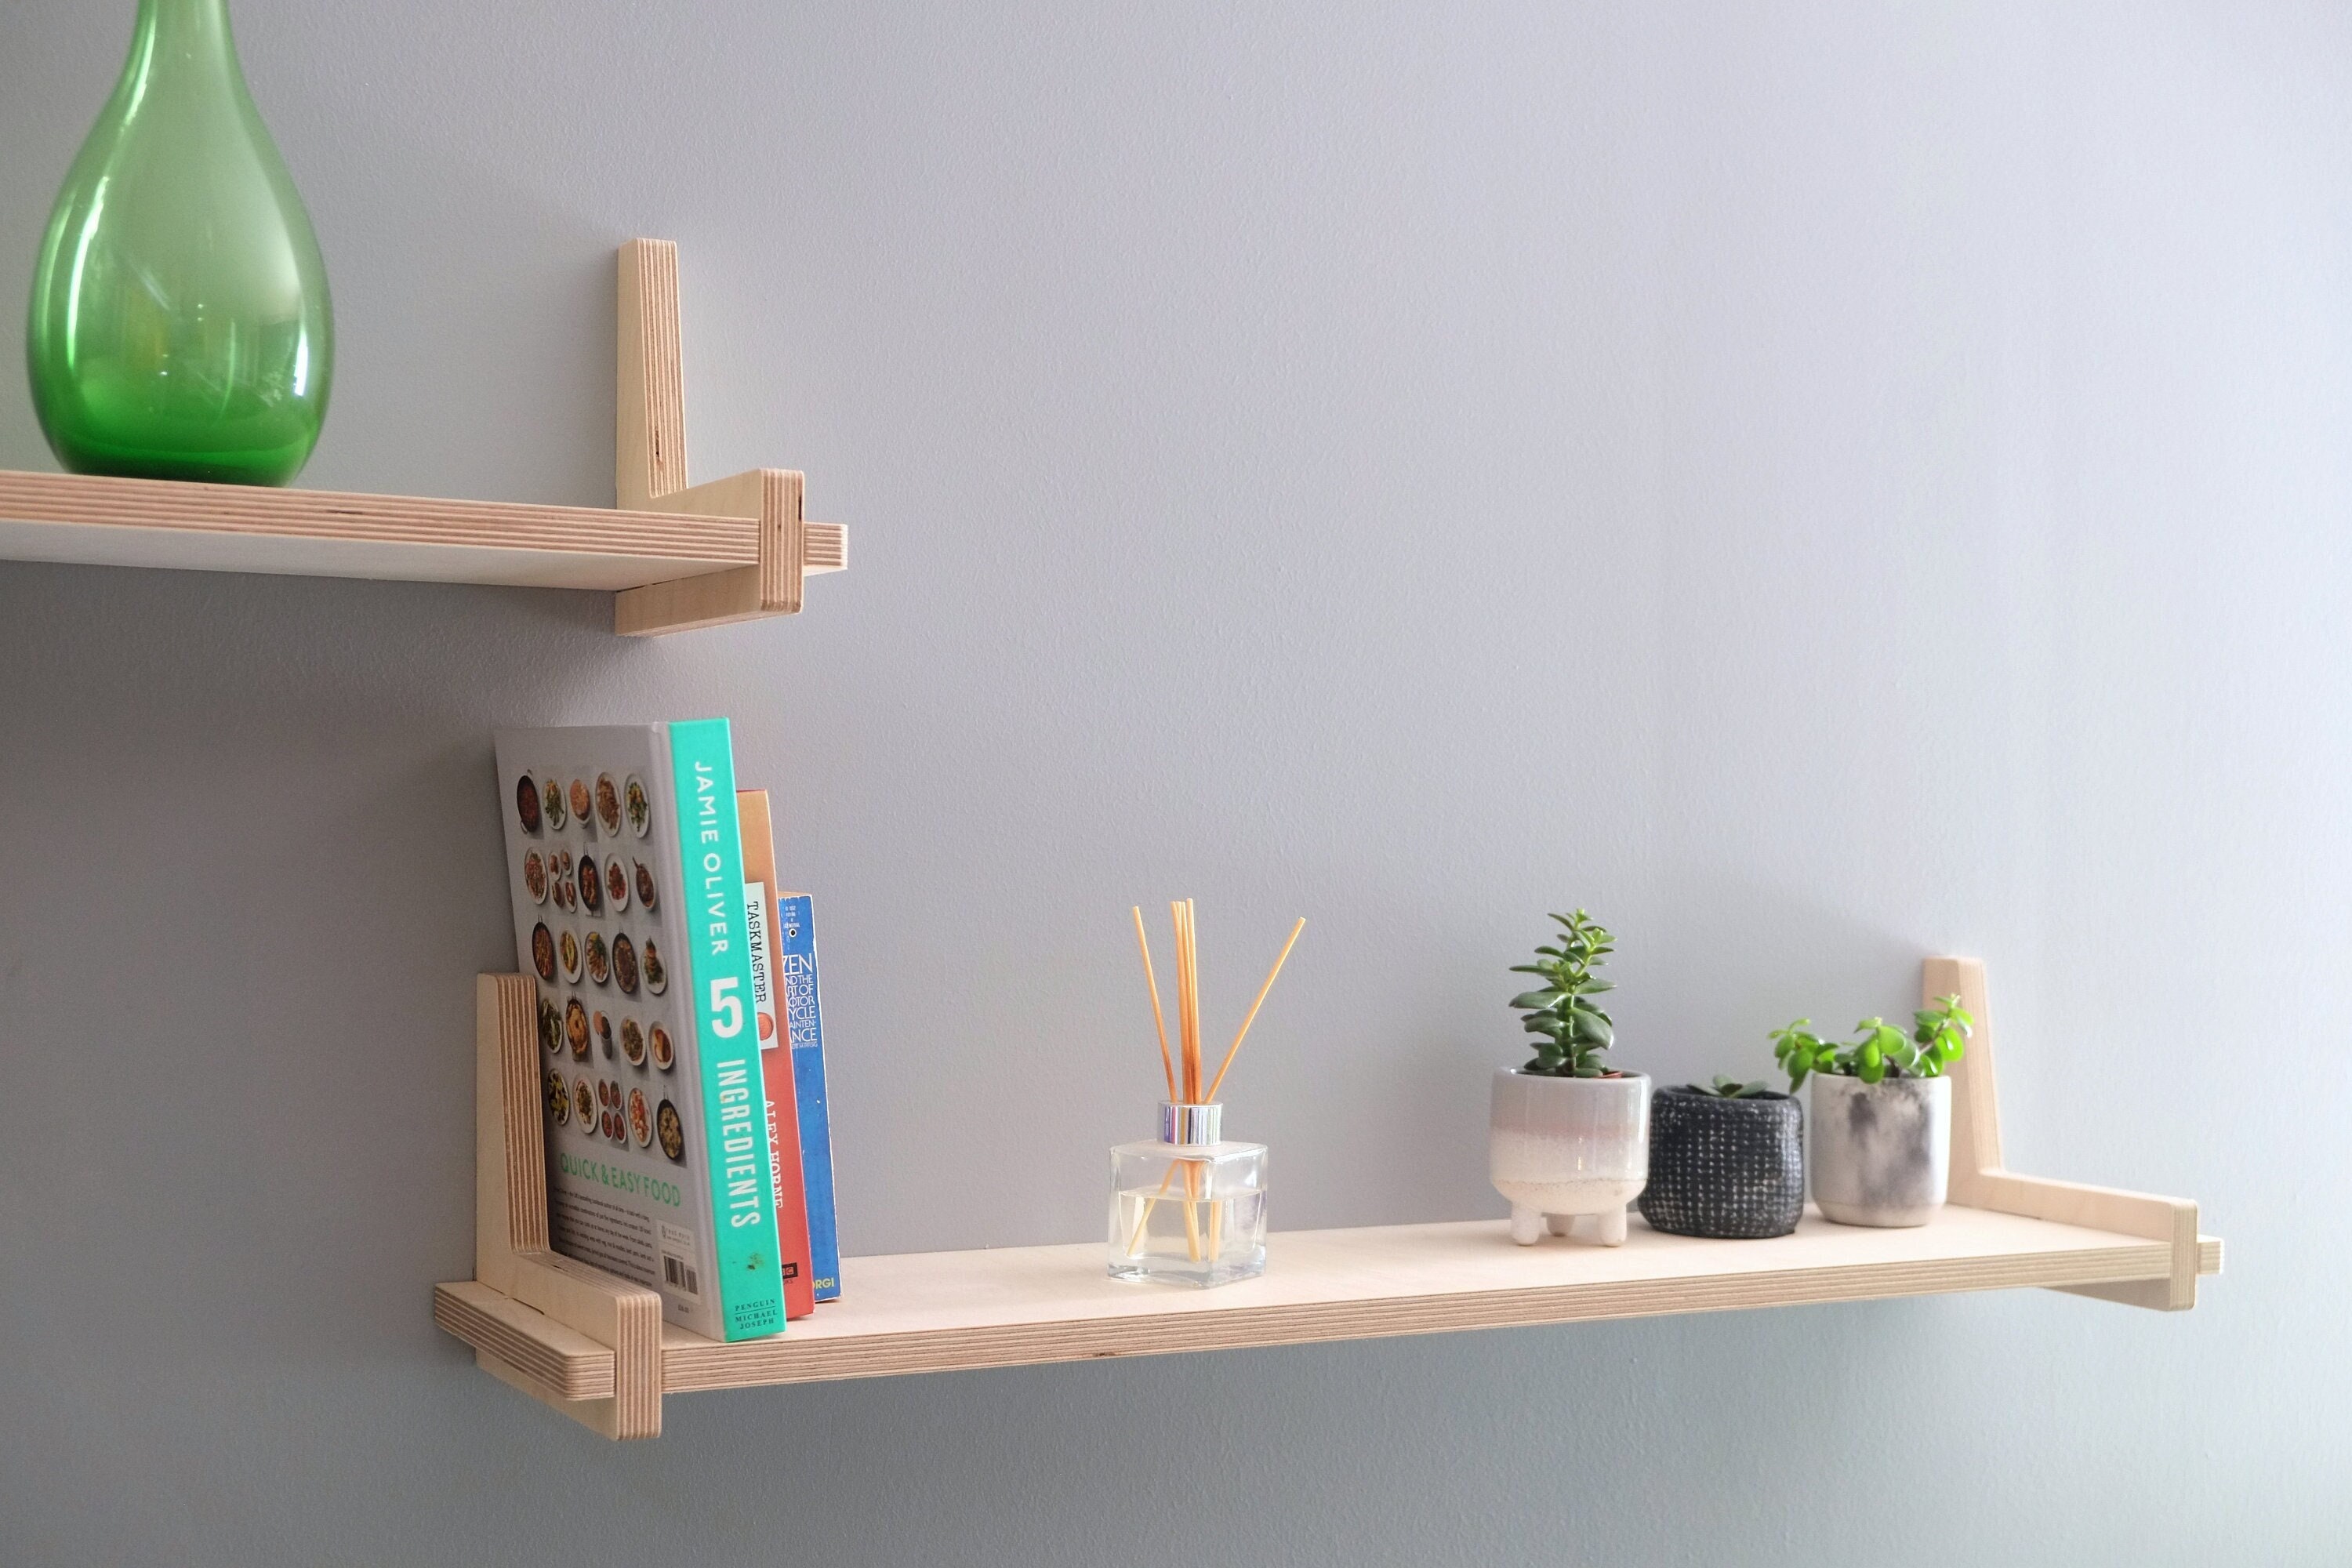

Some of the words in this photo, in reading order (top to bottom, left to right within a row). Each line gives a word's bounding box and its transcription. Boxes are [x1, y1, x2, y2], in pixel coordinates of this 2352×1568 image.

[695, 760, 720, 844] JAMIE
[703, 852, 729, 956] OLIVER
[746, 901, 766, 1004] TASKMASTER
[785, 975, 797, 985] ND
[798, 974, 814, 984] THE
[786, 985, 798, 996] RT
[799, 984, 814, 996] OF
[710, 976, 743, 1038] 5
[788, 996, 815, 1007] OTOR
[789, 1006, 816, 1021] YCLE
[789, 1019, 816, 1029] AINTEN-
[790, 1028, 817, 1043] NCE
[717, 1059, 760, 1228] INGREDIENTS
[560, 1152, 599, 1182] QUICK
[601, 1164, 609, 1185] &
[611, 1167, 641, 1194] EASY
[643, 1176, 681, 1207] FOOD
[812, 1277, 834, 1289] RGI
[735, 1298, 775, 1311] PENGUIN
[735, 1309, 778, 1323] MICHAEL
[739, 1318, 775, 1330] JOSEPH
